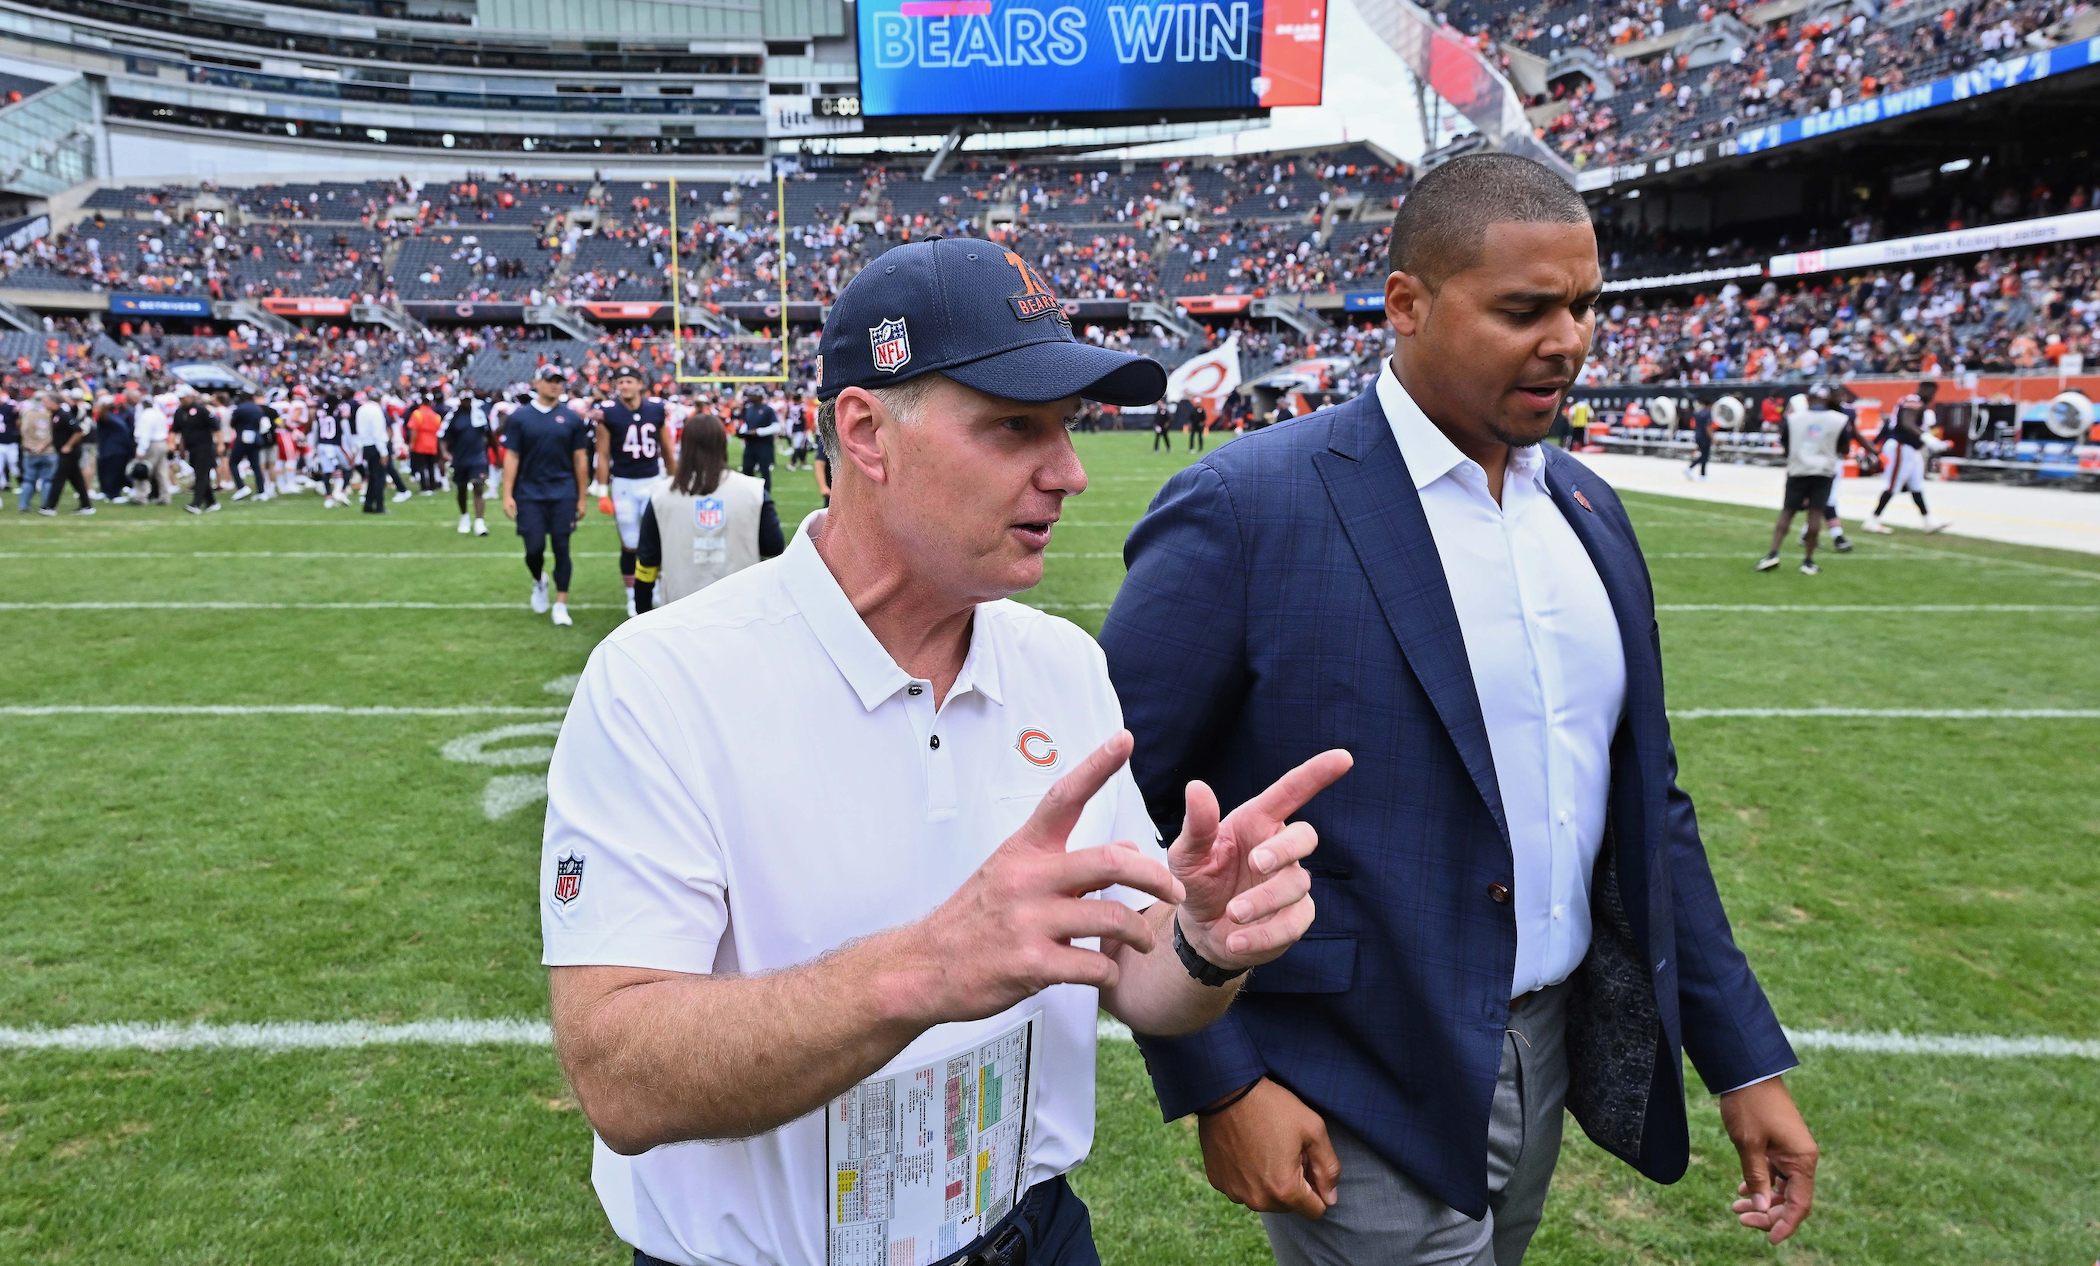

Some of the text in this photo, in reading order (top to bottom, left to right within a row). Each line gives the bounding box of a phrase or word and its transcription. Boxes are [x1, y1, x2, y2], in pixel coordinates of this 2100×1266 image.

[873, 2, 1249, 68] BEARS WIN
[1801, 86, 1933, 137] BEARS WIN
[1017, 294, 1058, 315] BEARS
[876, 339, 905, 365] NFL
[622, 422, 657, 459] 46
[698, 509, 722, 527] NFL
[557, 876, 579, 899] NFL
